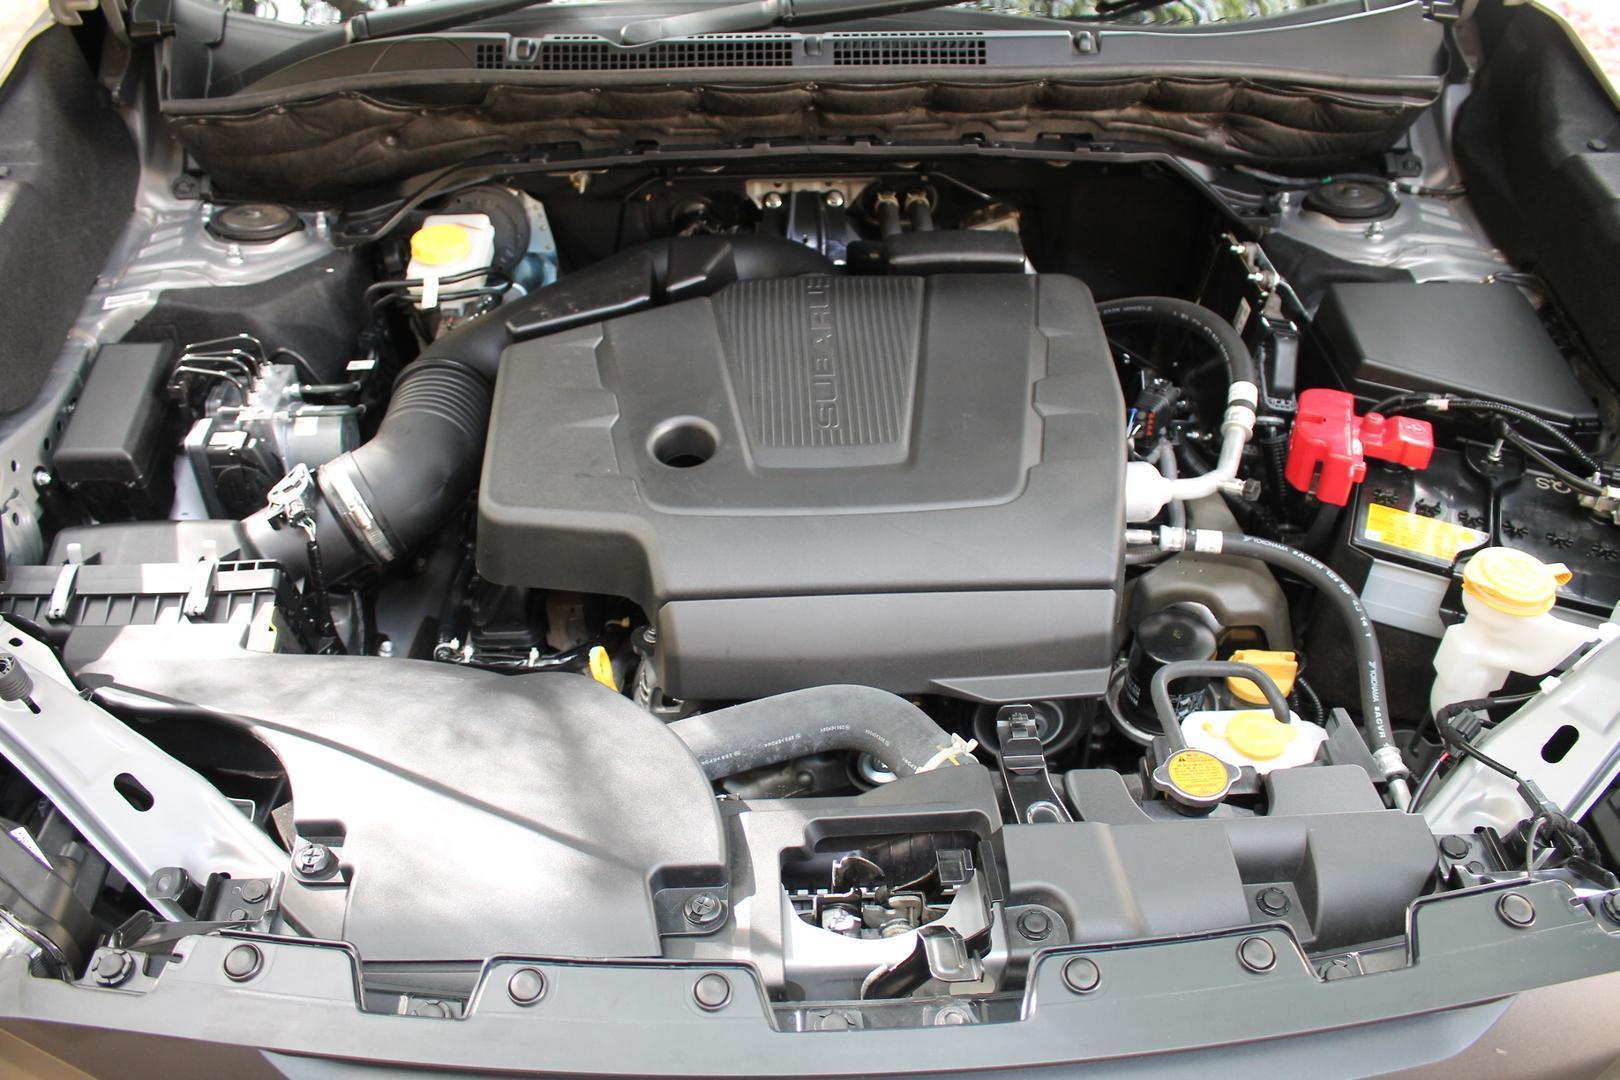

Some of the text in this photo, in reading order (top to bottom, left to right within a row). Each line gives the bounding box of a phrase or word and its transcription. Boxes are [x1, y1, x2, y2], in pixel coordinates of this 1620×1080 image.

[806, 290, 840, 429] SUBARU
[1253, 538, 1289, 552] YOKOHAMA
[1369, 670, 1380, 703] YOKOHAMA
